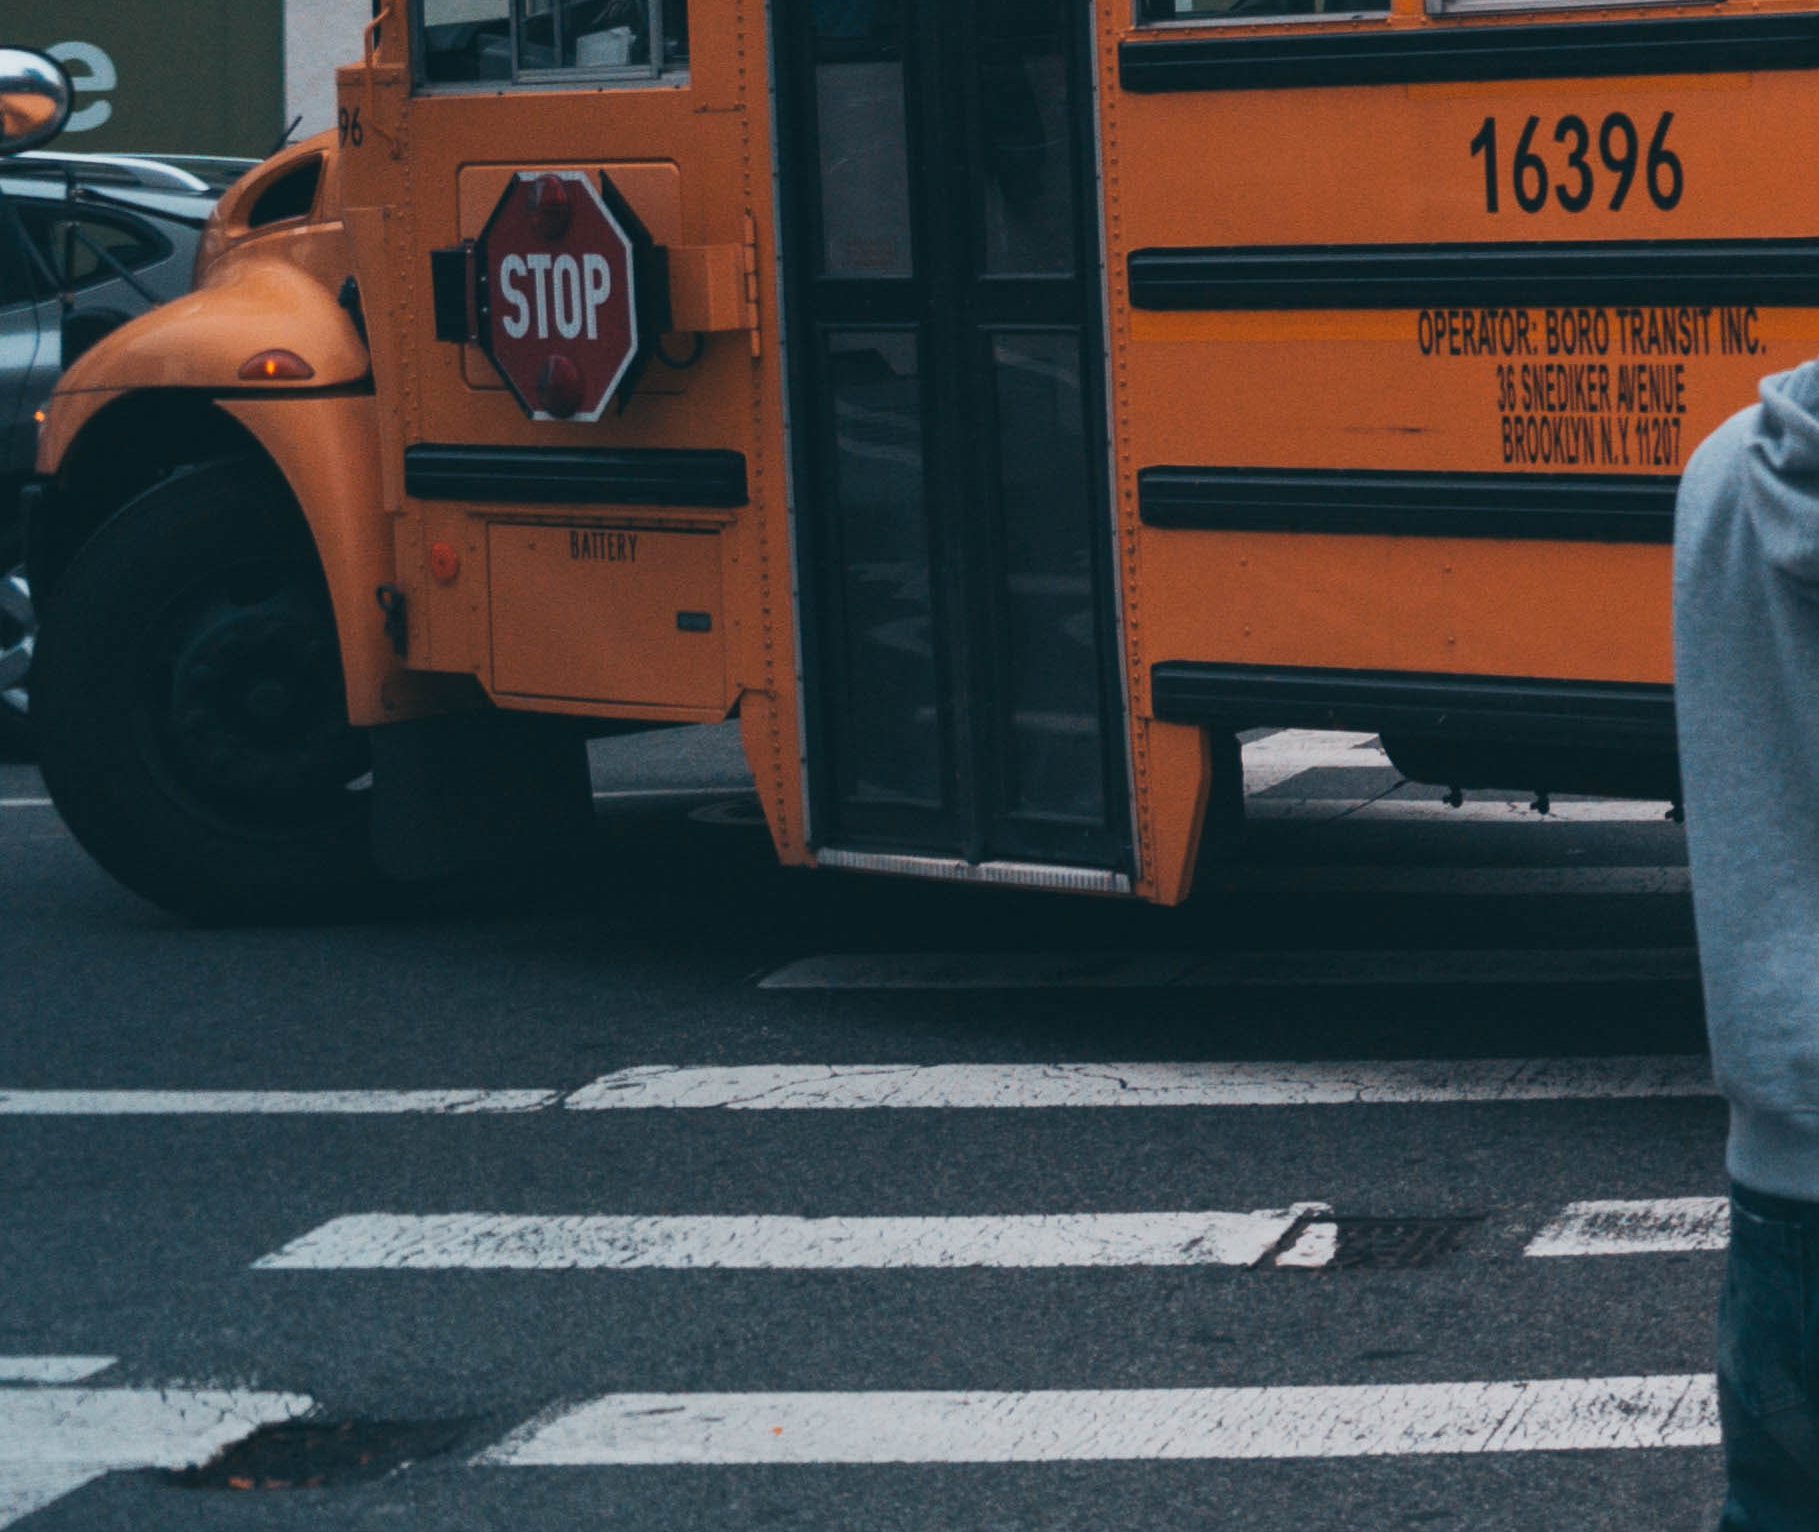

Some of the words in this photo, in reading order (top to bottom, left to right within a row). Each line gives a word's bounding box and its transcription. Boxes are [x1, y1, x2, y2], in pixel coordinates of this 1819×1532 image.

[1470, 111, 1684, 214] 16396
[500, 253, 611, 340] STOP
[1417, 309, 1539, 357] OPERATOR:
[1546, 308, 1610, 356] BORO
[1615, 307, 1711, 356] TRANSIT
[1720, 307, 1767, 356] INC.
[1497, 364, 1517, 412] 36
[1521, 364, 1611, 412] SNEDIKER
[1617, 364, 1687, 414] AVENUE
[1502, 416, 1595, 464] BROOKLYN
[1635, 417, 1682, 466] 11207
[569, 531, 638, 564] BATTERY
